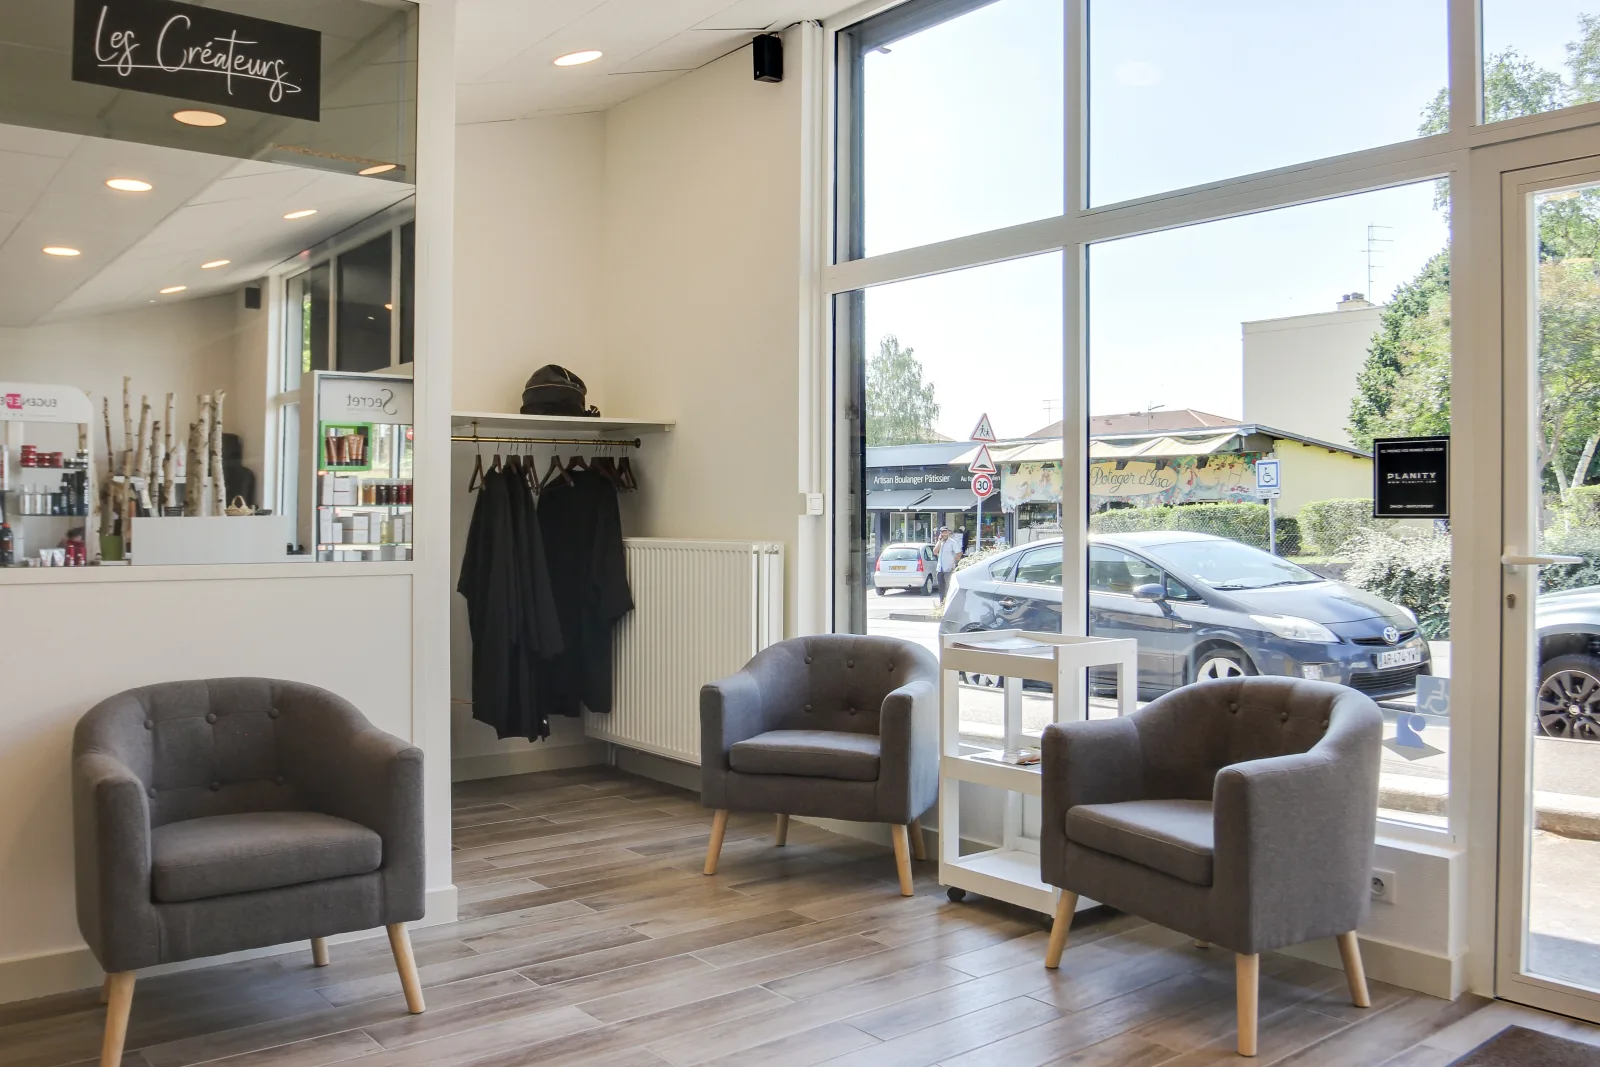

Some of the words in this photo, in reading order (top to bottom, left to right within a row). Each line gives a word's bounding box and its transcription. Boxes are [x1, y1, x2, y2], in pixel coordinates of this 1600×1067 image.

[95, 5, 140, 77] Les
[157, 14, 290, 103] Créateurs
[873, 476, 894, 485] Artisan
[894, 475, 924, 486] Boulanger
[924, 473, 951, 483] Pâtissier
[1090, 466, 1135, 494] Potager
[1387, 472, 1437, 480] PLANITY
[976, 480, 989, 491] 30
